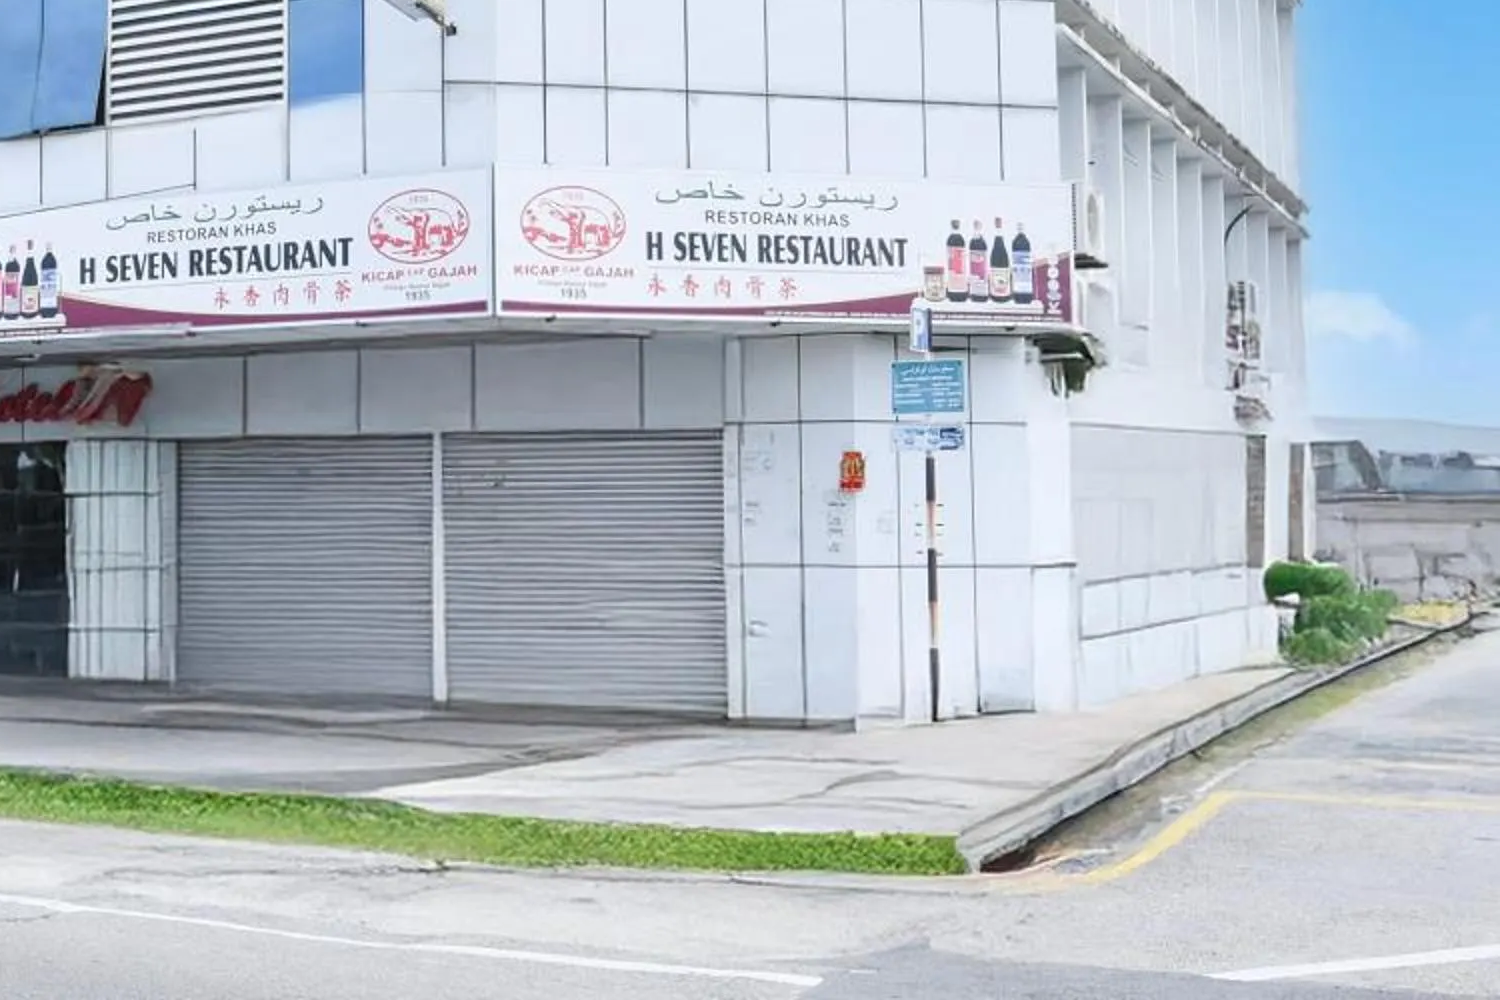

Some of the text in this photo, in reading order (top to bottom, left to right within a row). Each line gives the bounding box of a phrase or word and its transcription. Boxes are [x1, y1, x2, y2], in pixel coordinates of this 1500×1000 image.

[705, 208, 850, 228] RESTORAN KHAS
[147, 221, 277, 243] RESTORAN KHAS
[646, 231, 908, 268] H SEVEN RESTAURANT
[80, 237, 354, 285] H SEVEN RESTAURANT
[361, 270, 404, 284] KICAP
[427, 265, 477, 279] GAJAH
